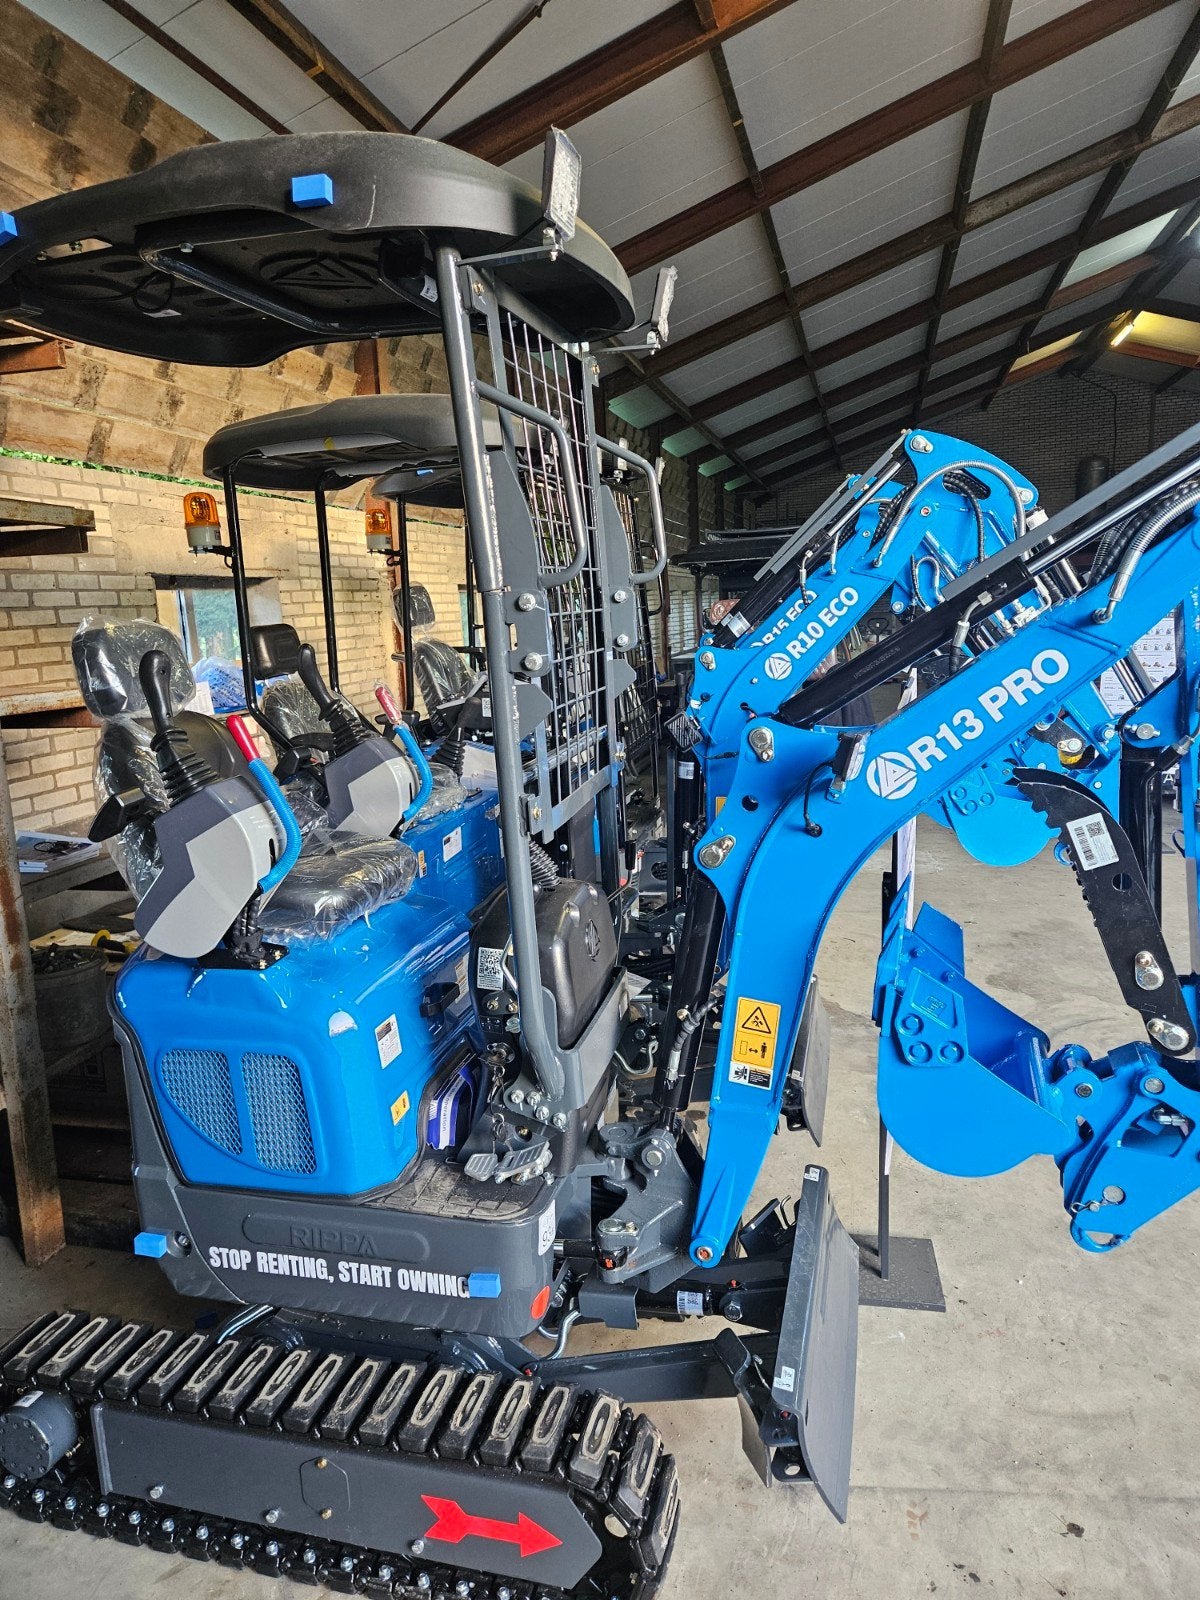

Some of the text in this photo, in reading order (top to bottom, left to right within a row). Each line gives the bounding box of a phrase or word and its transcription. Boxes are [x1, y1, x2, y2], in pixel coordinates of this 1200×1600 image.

[762, 618, 789, 645] R15
[786, 621, 824, 660] R10
[818, 587, 859, 628] ECO
[907, 708, 984, 772] R13
[978, 649, 1069, 723] PRO
[289, 1226, 378, 1255] RIPPA
[208, 1246, 470, 1299] STOP RENTING, START OWNING
